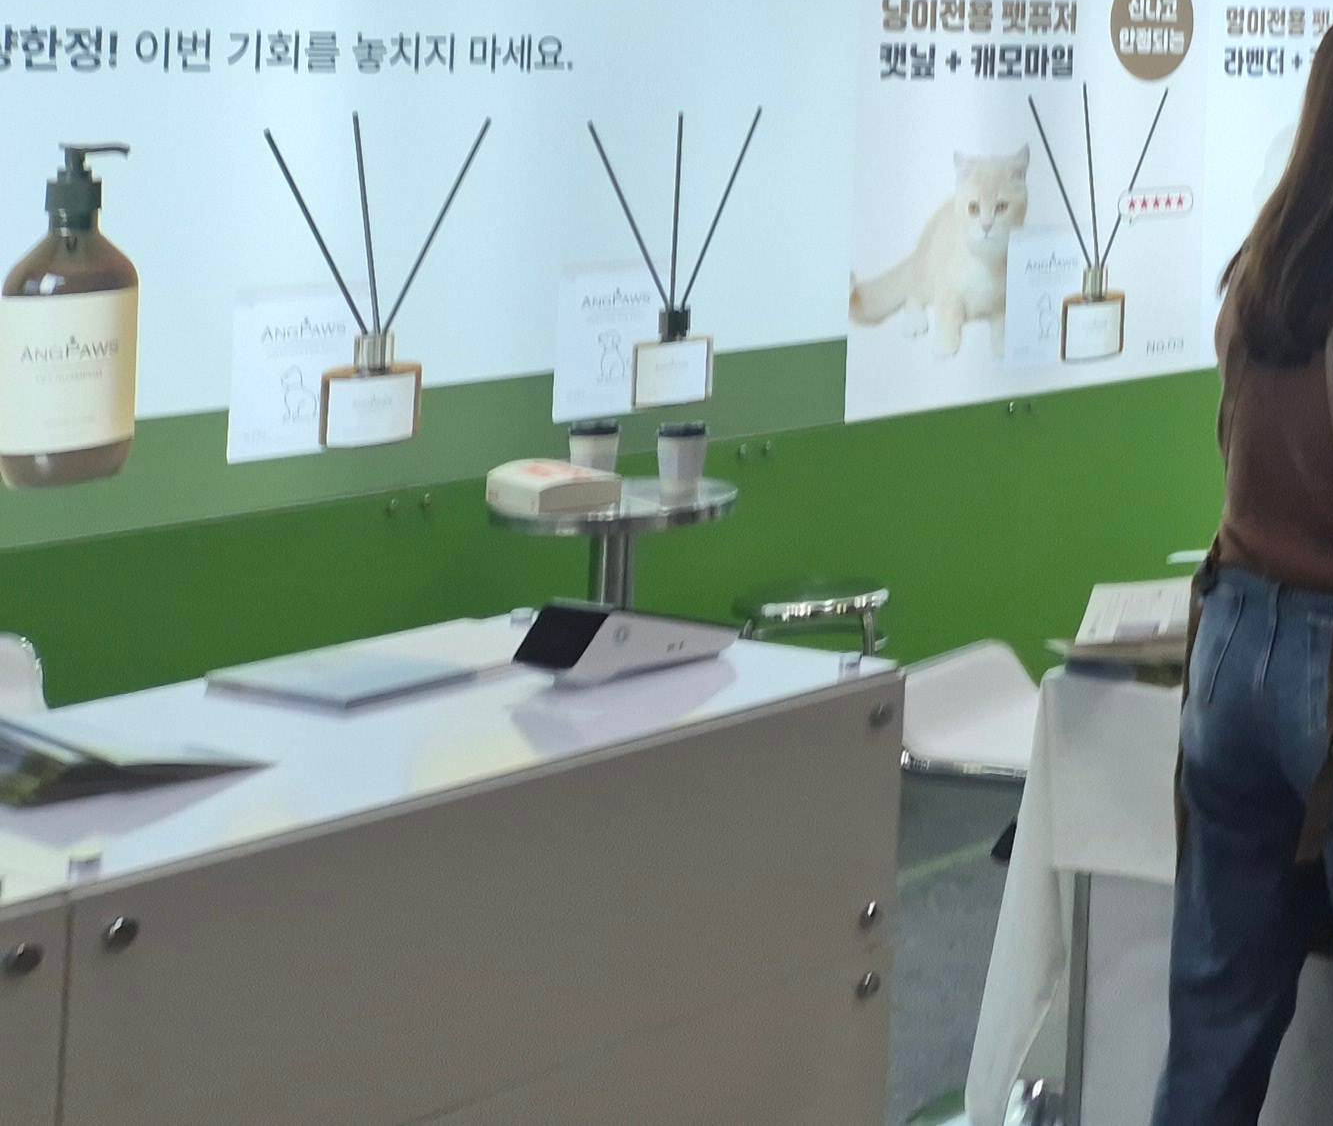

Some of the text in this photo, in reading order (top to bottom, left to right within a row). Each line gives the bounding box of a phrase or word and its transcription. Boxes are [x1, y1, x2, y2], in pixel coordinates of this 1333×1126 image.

[135, 26, 211, 74] 이번
[227, 29, 340, 74] 기회를
[352, 31, 455, 74] 놓치지
[469, 33, 573, 74] 마세요.
[945, 50, 962, 74] +
[970, 42, 1075, 82] 캐모마일
[1223, 45, 1286, 79] 라벤더
